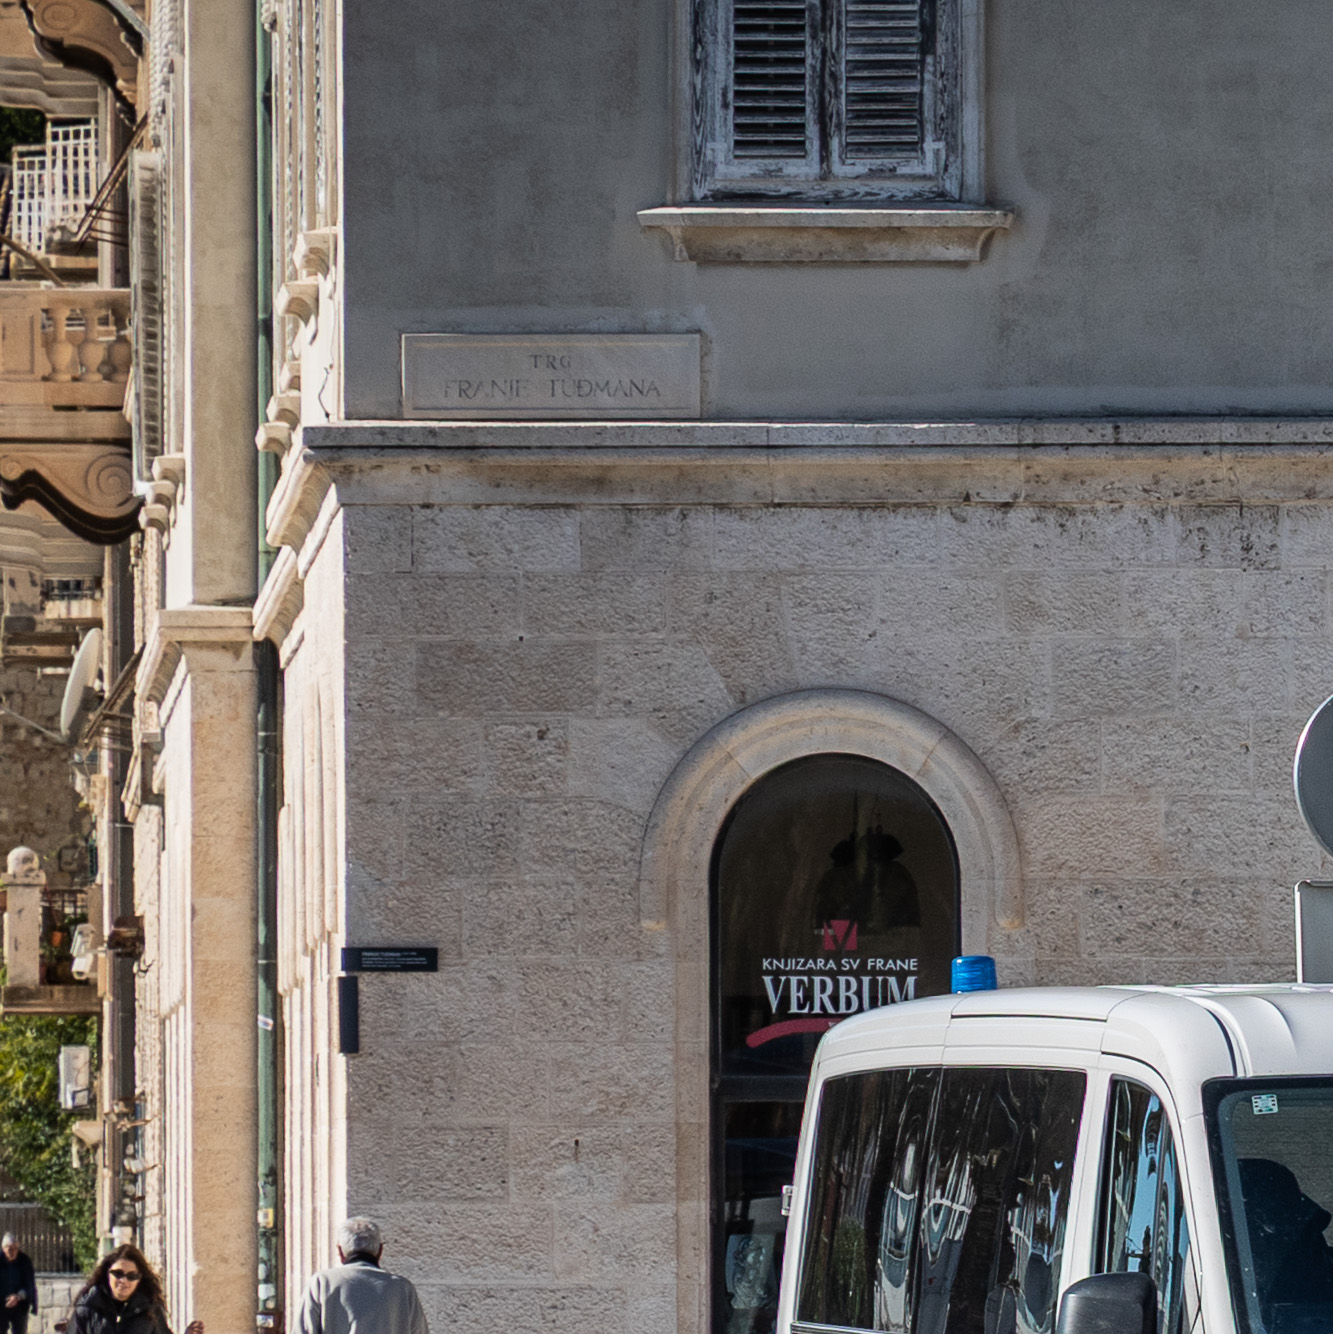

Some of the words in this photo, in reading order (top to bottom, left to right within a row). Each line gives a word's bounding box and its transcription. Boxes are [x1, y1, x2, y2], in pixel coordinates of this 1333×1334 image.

[529, 354, 571, 369] TRG
[762, 958, 836, 971] KNJIZARA
[840, 958, 860, 971] SV
[868, 958, 918, 971] FRANE
[762, 975, 918, 1014] VERBUM
